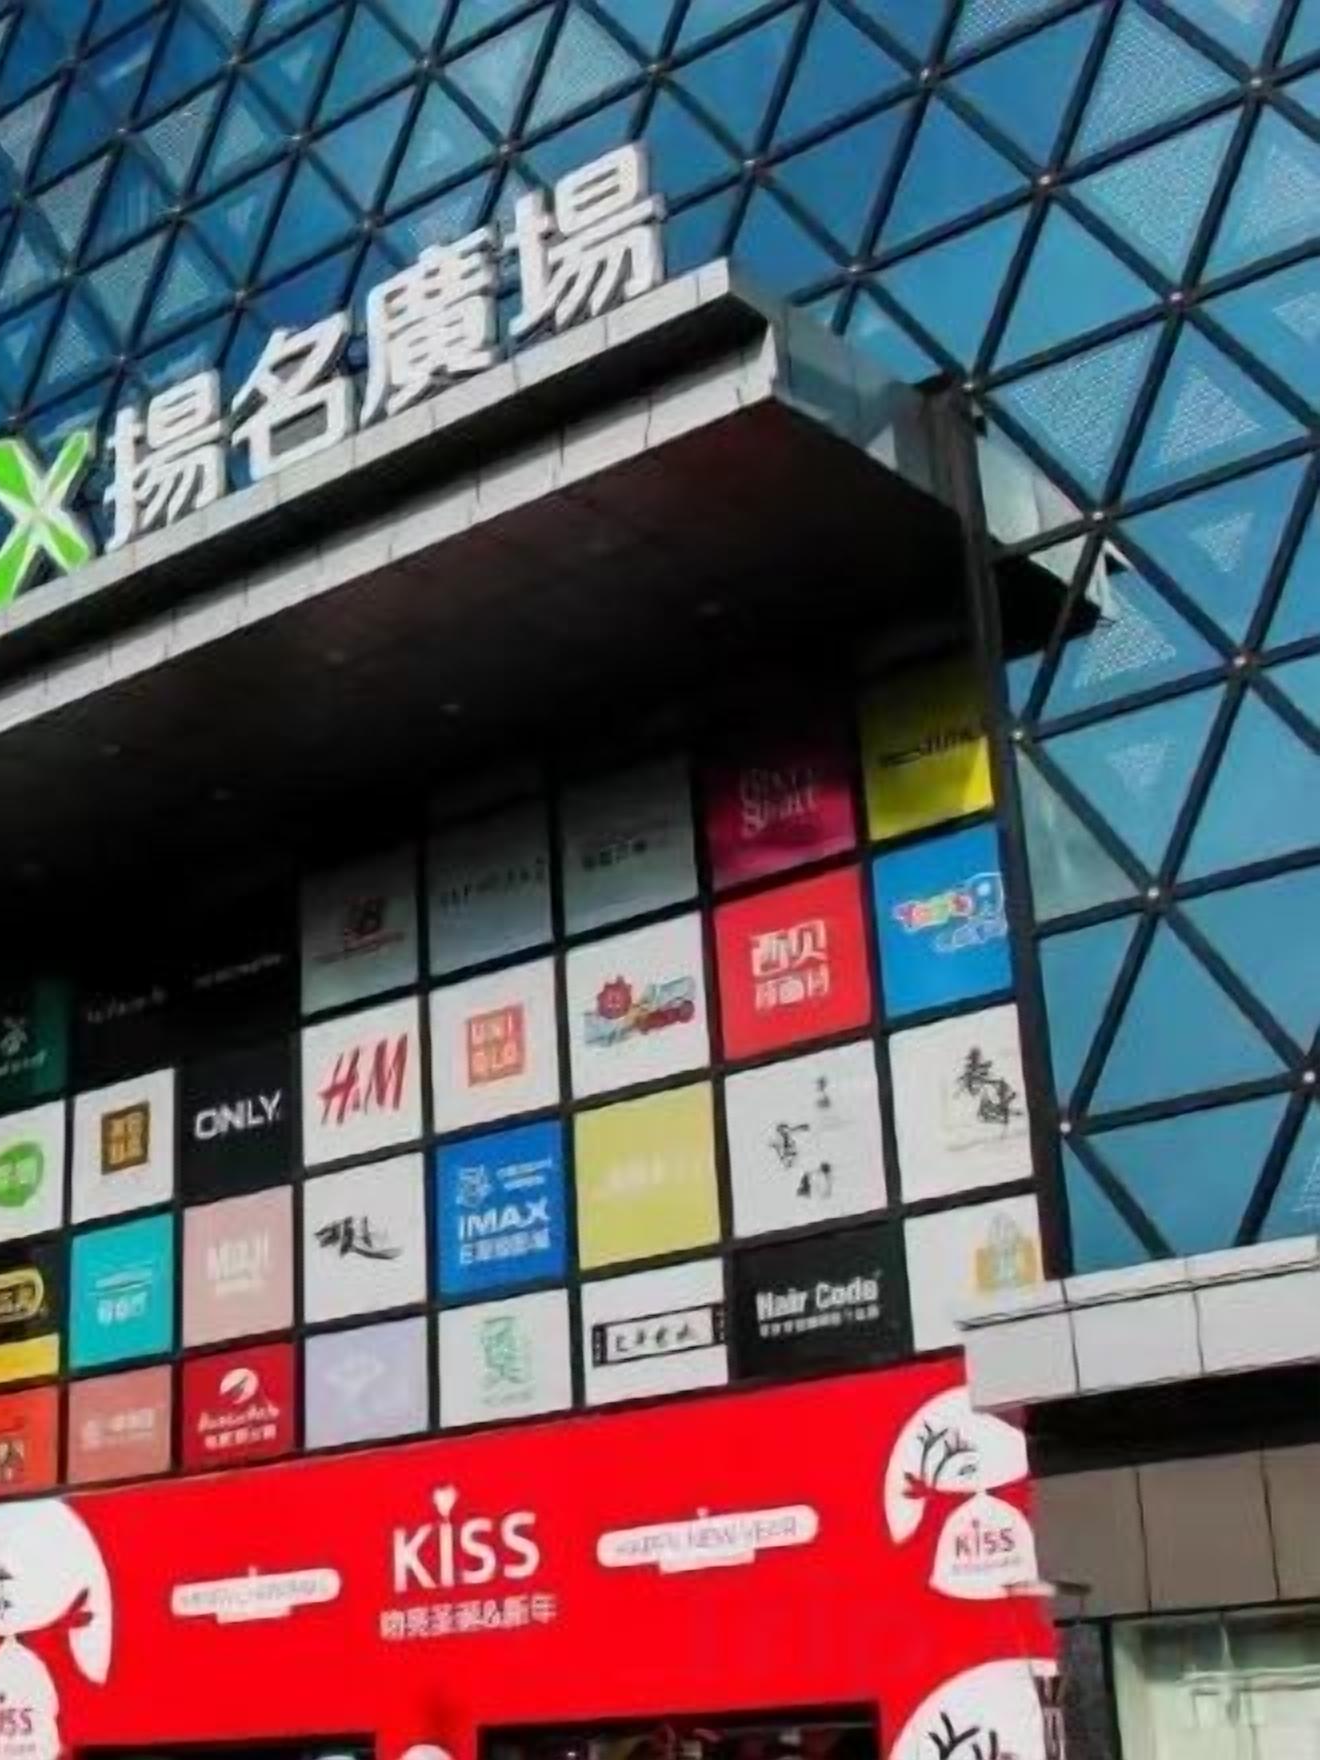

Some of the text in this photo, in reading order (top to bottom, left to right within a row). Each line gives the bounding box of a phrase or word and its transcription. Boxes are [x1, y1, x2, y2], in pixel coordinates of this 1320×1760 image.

[104, 139, 667, 552] 揚名廣場
[317, 1034, 408, 1126] H&M
[194, 1088, 282, 1141] ONLY
[458, 1195, 550, 1242] IMAX
[756, 1286, 808, 1321] Hair
[815, 1275, 879, 1309] Code
